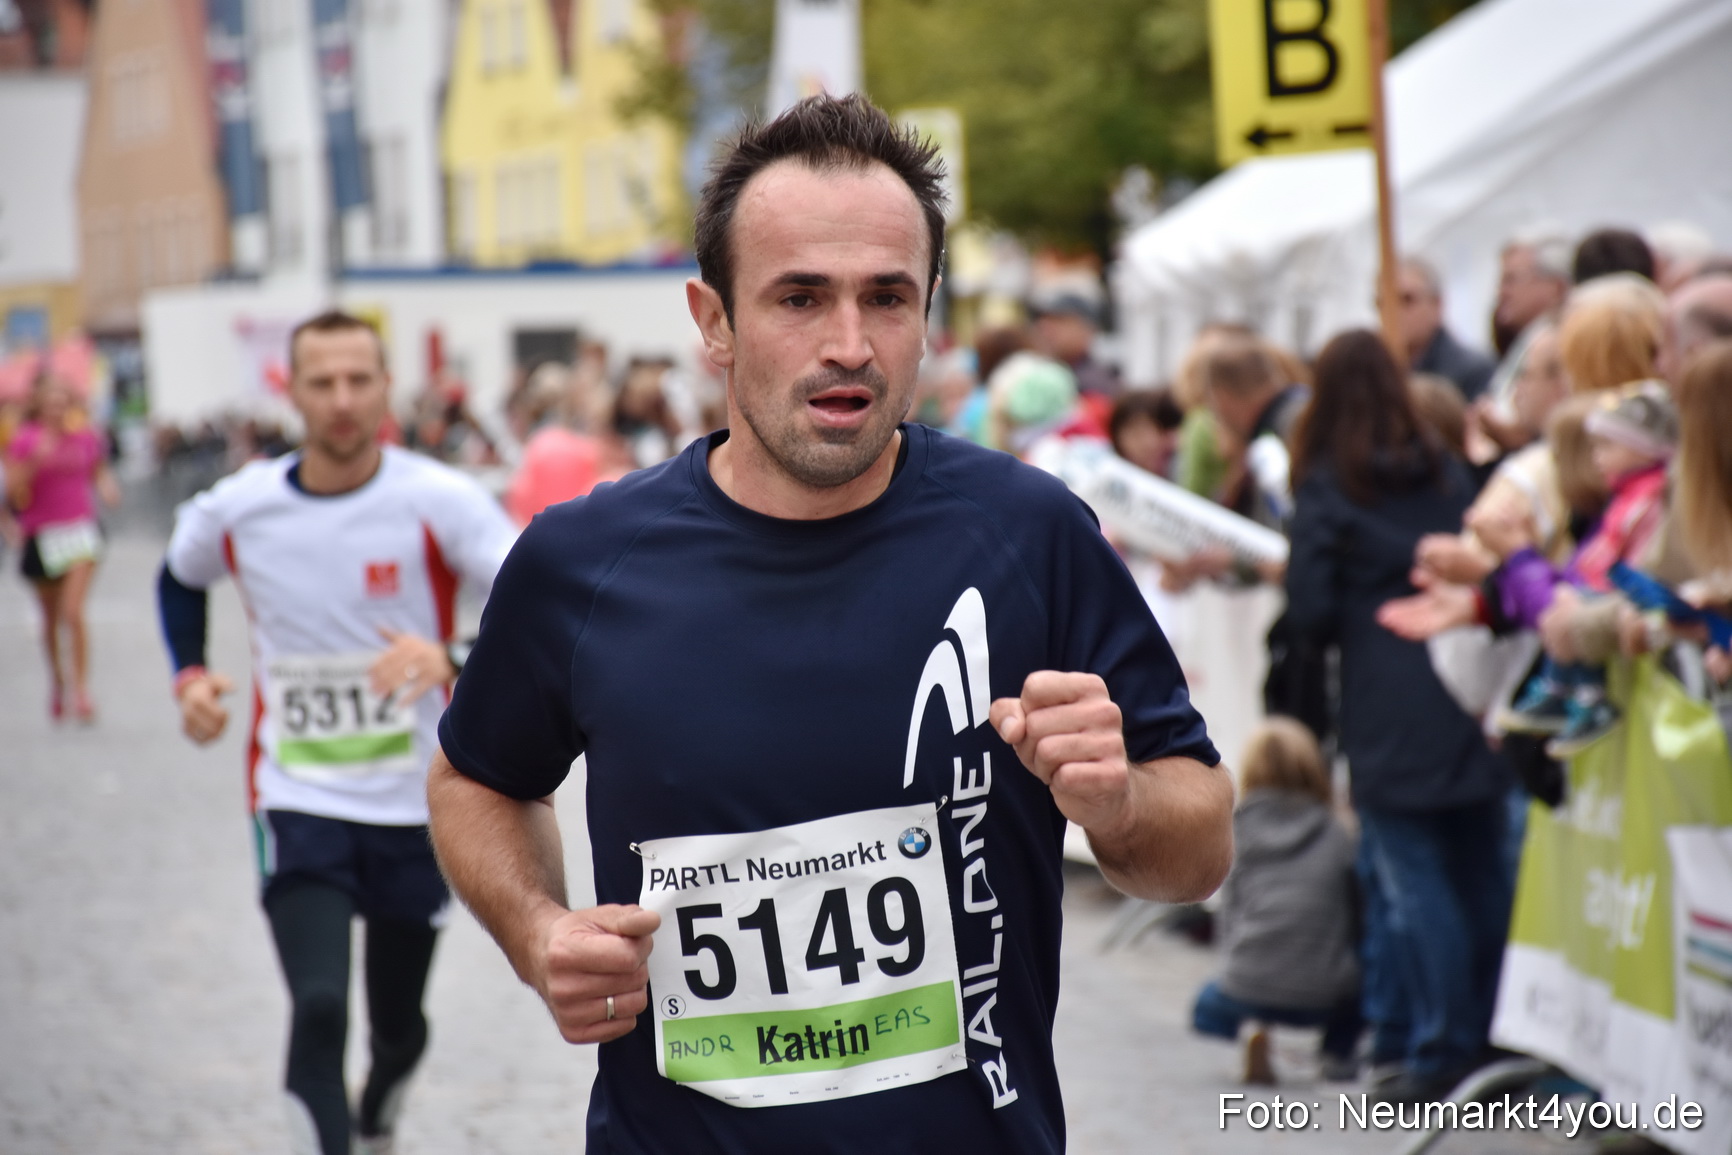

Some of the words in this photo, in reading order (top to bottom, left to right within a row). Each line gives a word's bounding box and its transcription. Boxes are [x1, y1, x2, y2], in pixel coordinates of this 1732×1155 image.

[1264, 0, 1339, 97] B
[649, 863, 740, 892] PARTL
[746, 840, 887, 882] Neumarkt
[675, 876, 926, 1001] 5149
[667, 1033, 735, 1060] ANDR
[874, 1005, 931, 1036] EAS
[756, 1019, 870, 1065] Katrin
